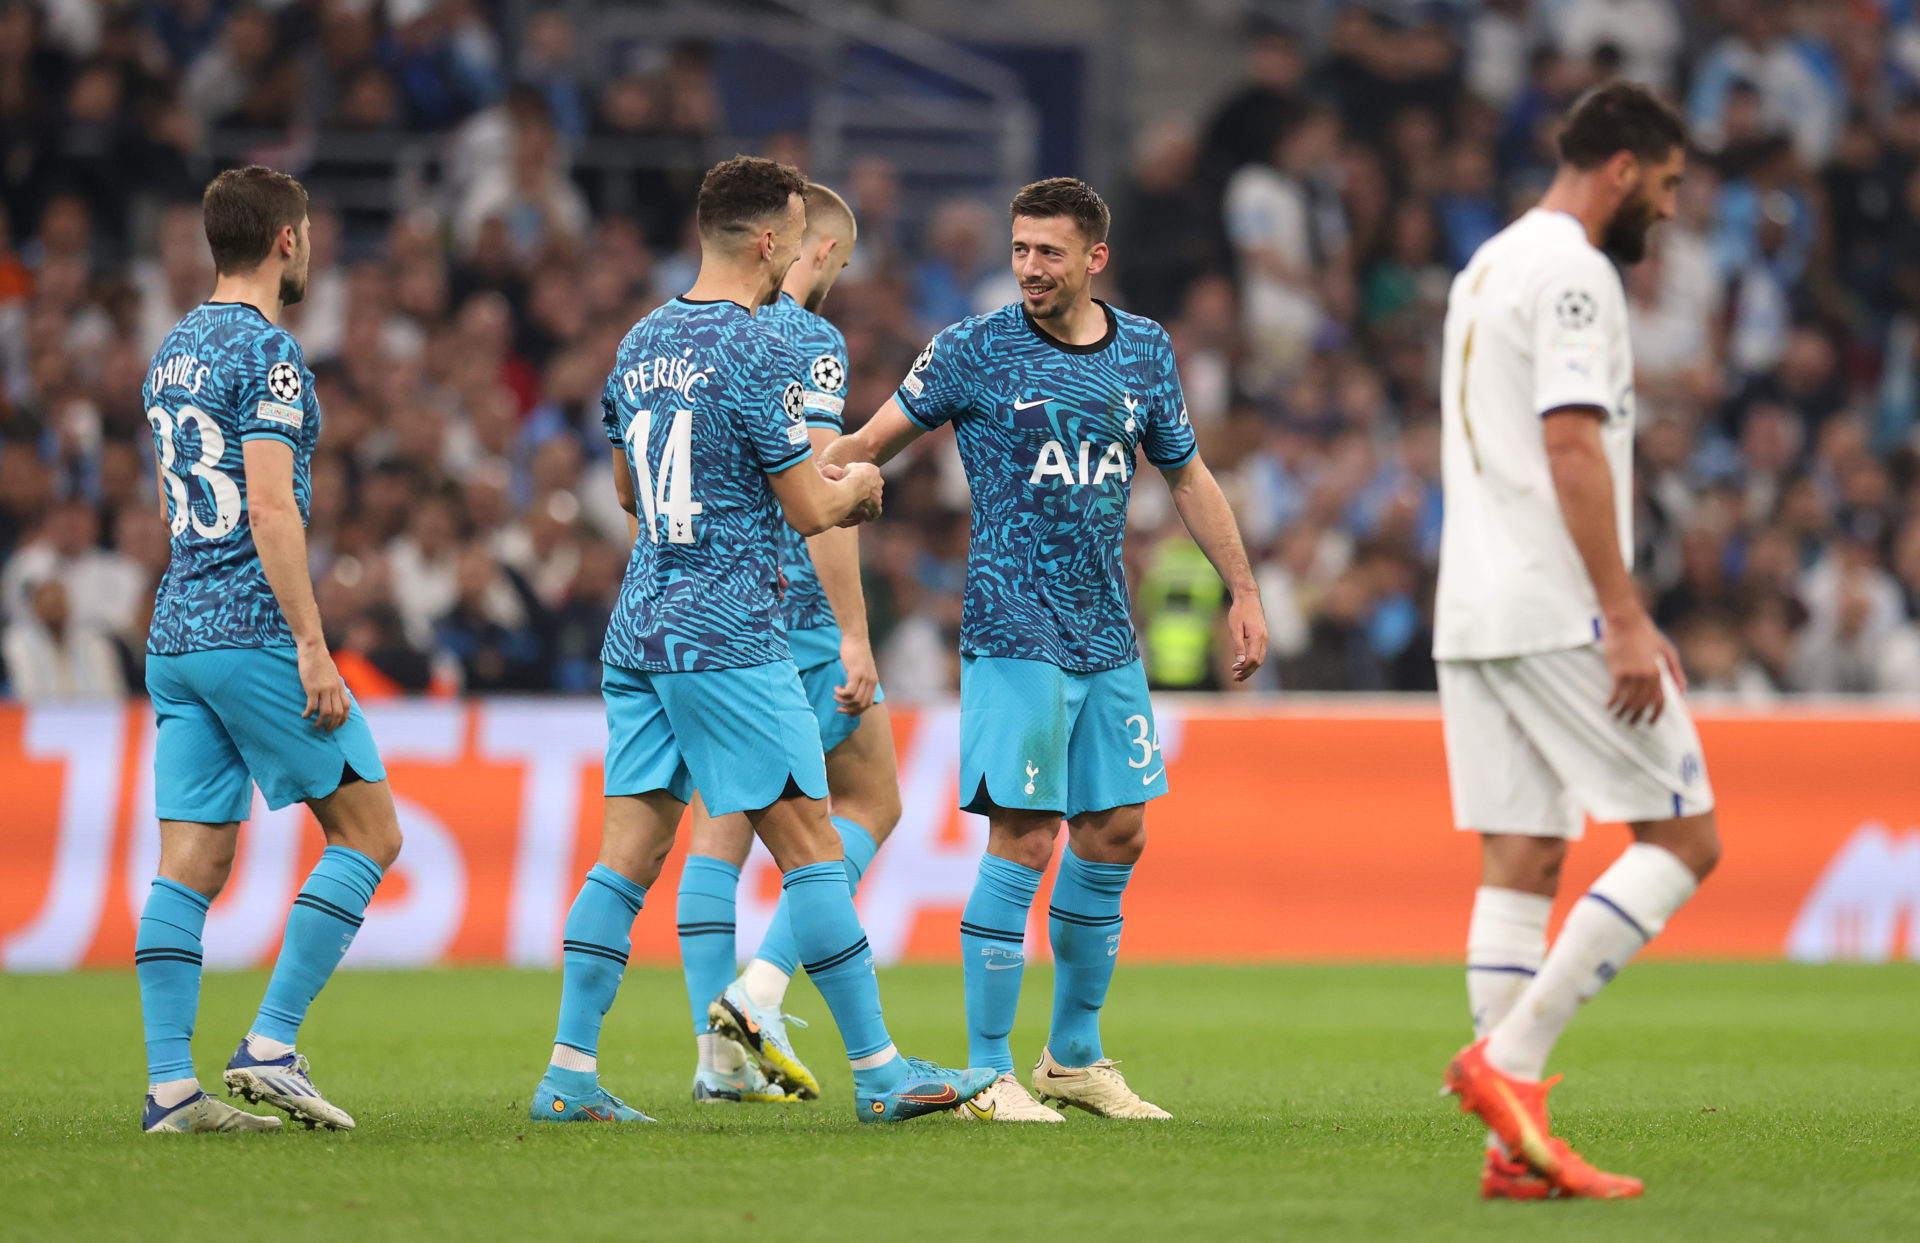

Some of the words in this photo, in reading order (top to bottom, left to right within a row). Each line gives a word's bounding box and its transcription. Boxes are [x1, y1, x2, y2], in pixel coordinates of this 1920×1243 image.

[152, 355, 210, 397] DAVIES
[624, 347, 716, 403] PERIŠIĆ
[625, 410, 703, 544] 14
[1029, 440, 1128, 485] AIA
